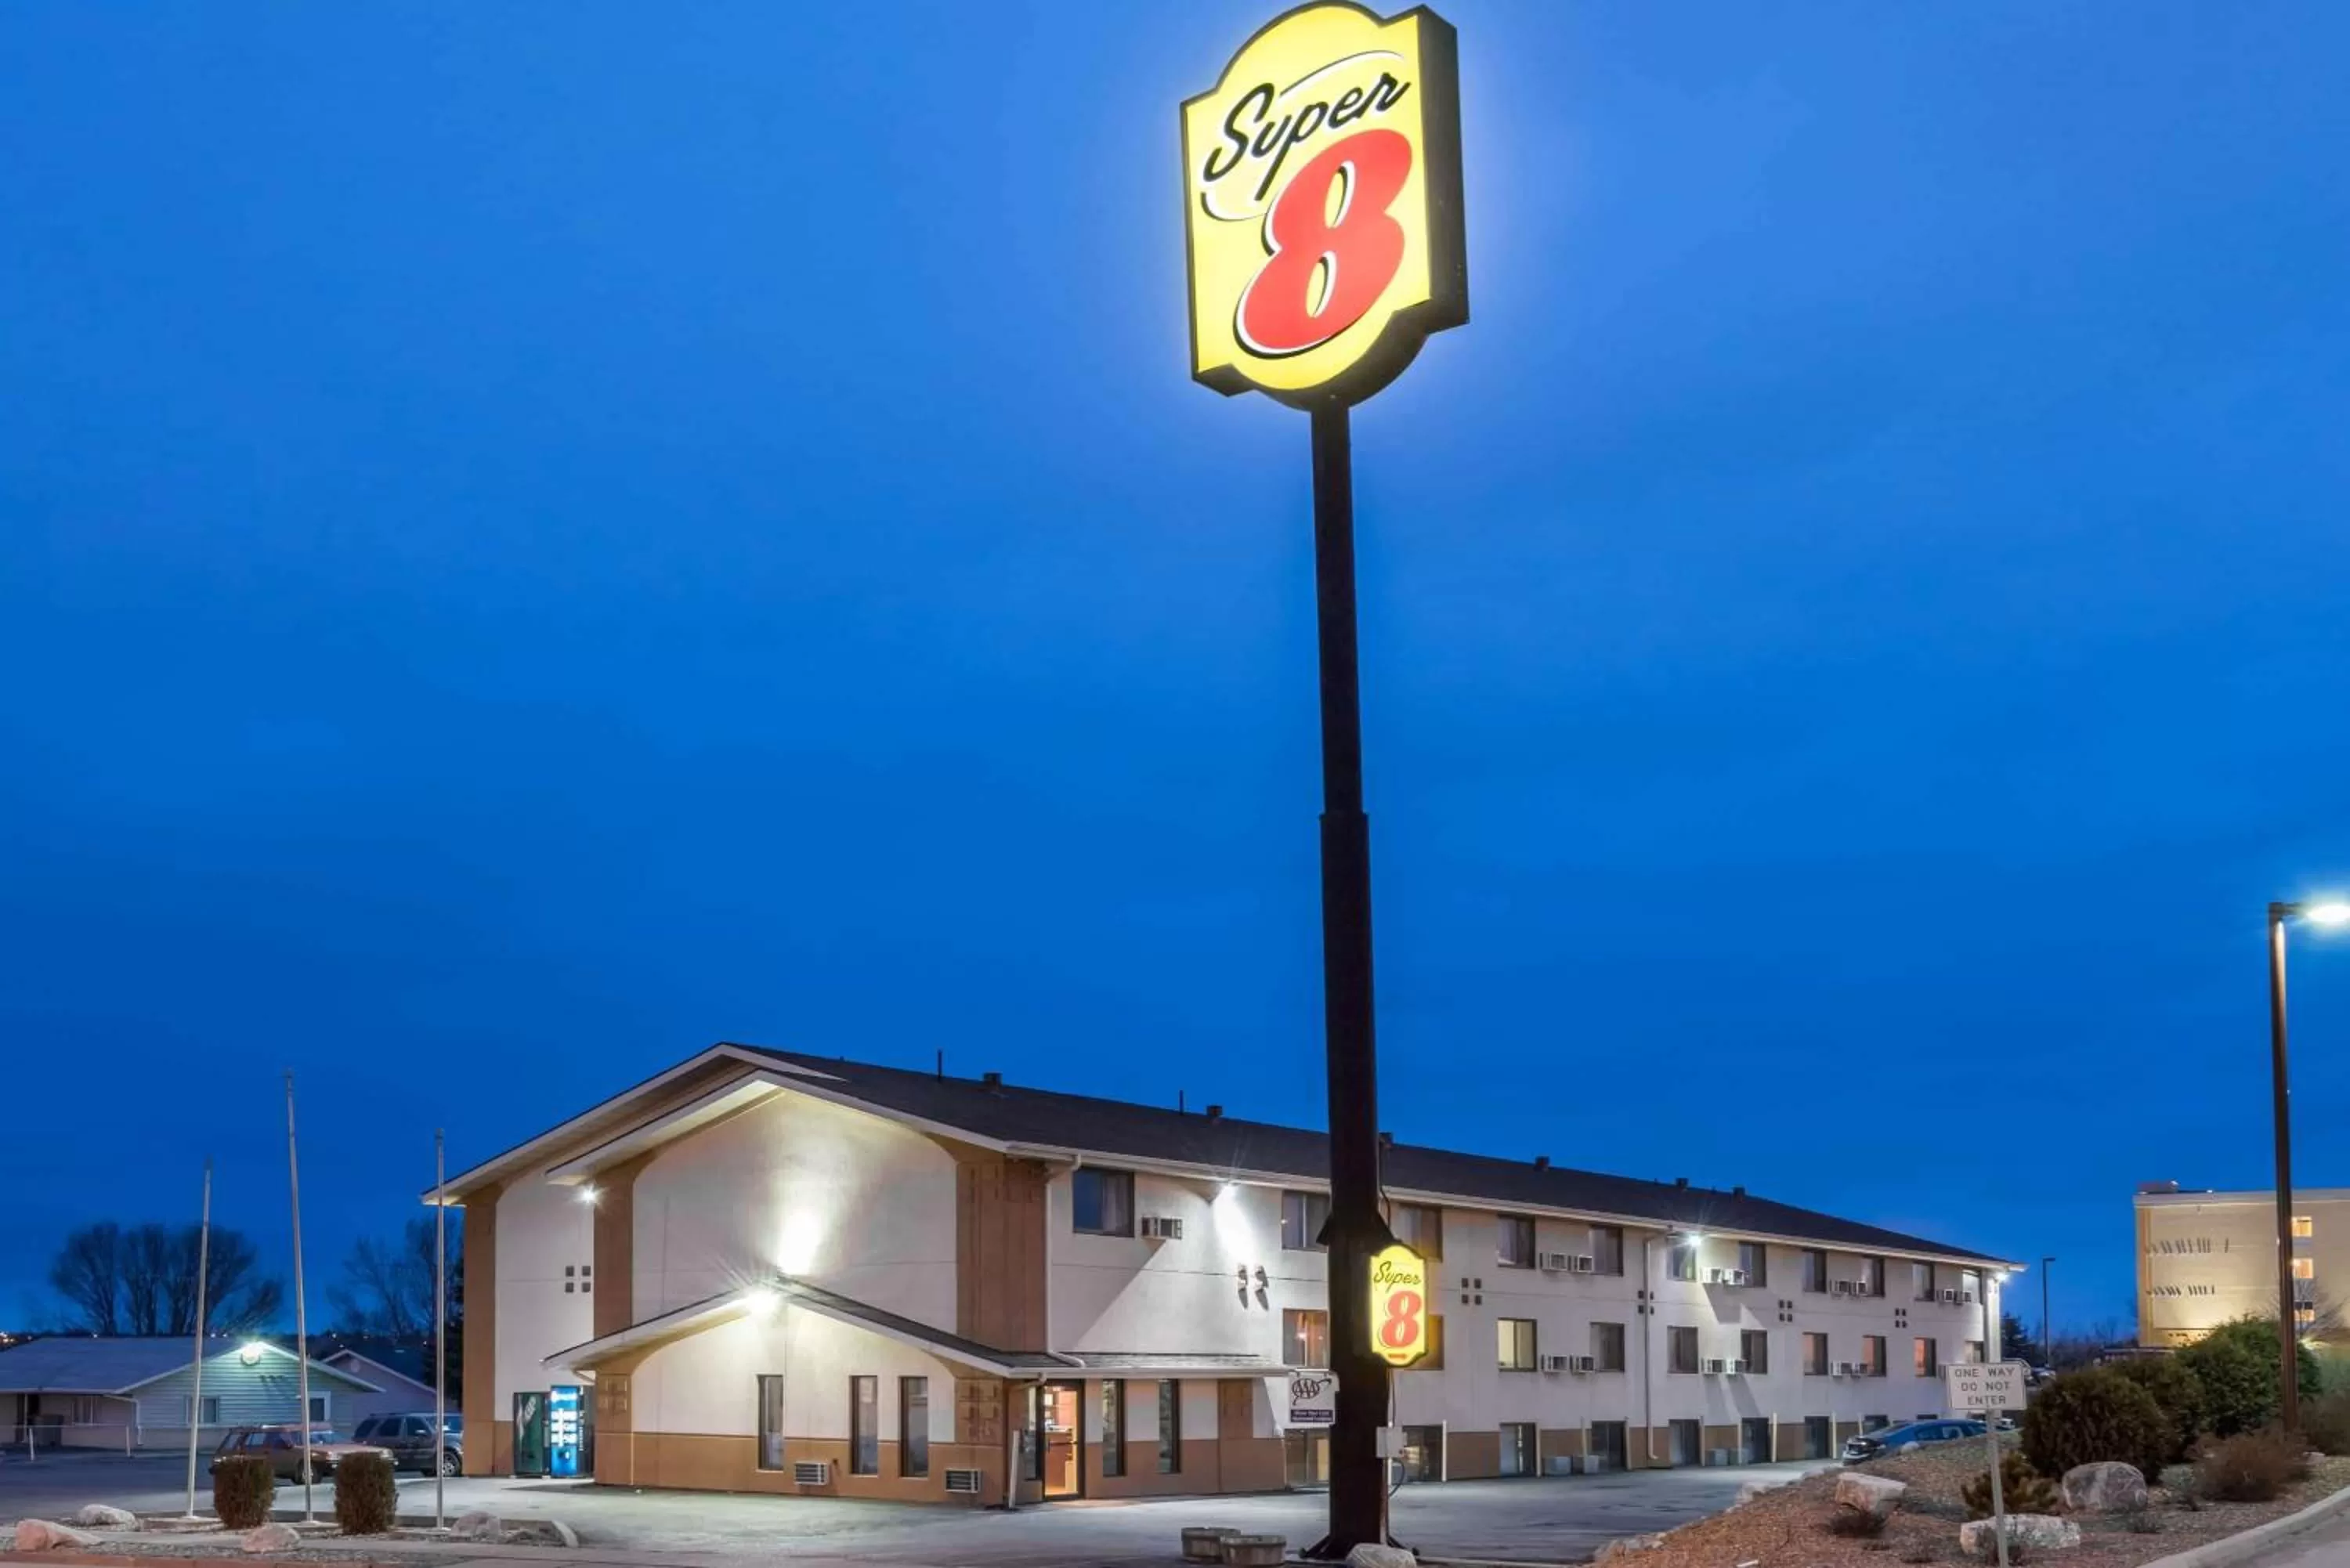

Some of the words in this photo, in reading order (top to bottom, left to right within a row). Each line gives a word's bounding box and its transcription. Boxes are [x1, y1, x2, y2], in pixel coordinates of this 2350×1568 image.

[1203, 73, 1412, 201] Super
[1234, 128, 1413, 359] 8
[1373, 1261, 1422, 1293] Super
[1379, 1291, 1422, 1348] 8
[1955, 1368, 1979, 1378] ONE
[1988, 1367, 2015, 1377] WAY
[1293, 1379, 1319, 1399] AAA
[1961, 1382, 1978, 1392] DO
[1986, 1381, 2011, 1391] NOT
[1967, 1395, 2006, 1405] ENTER
